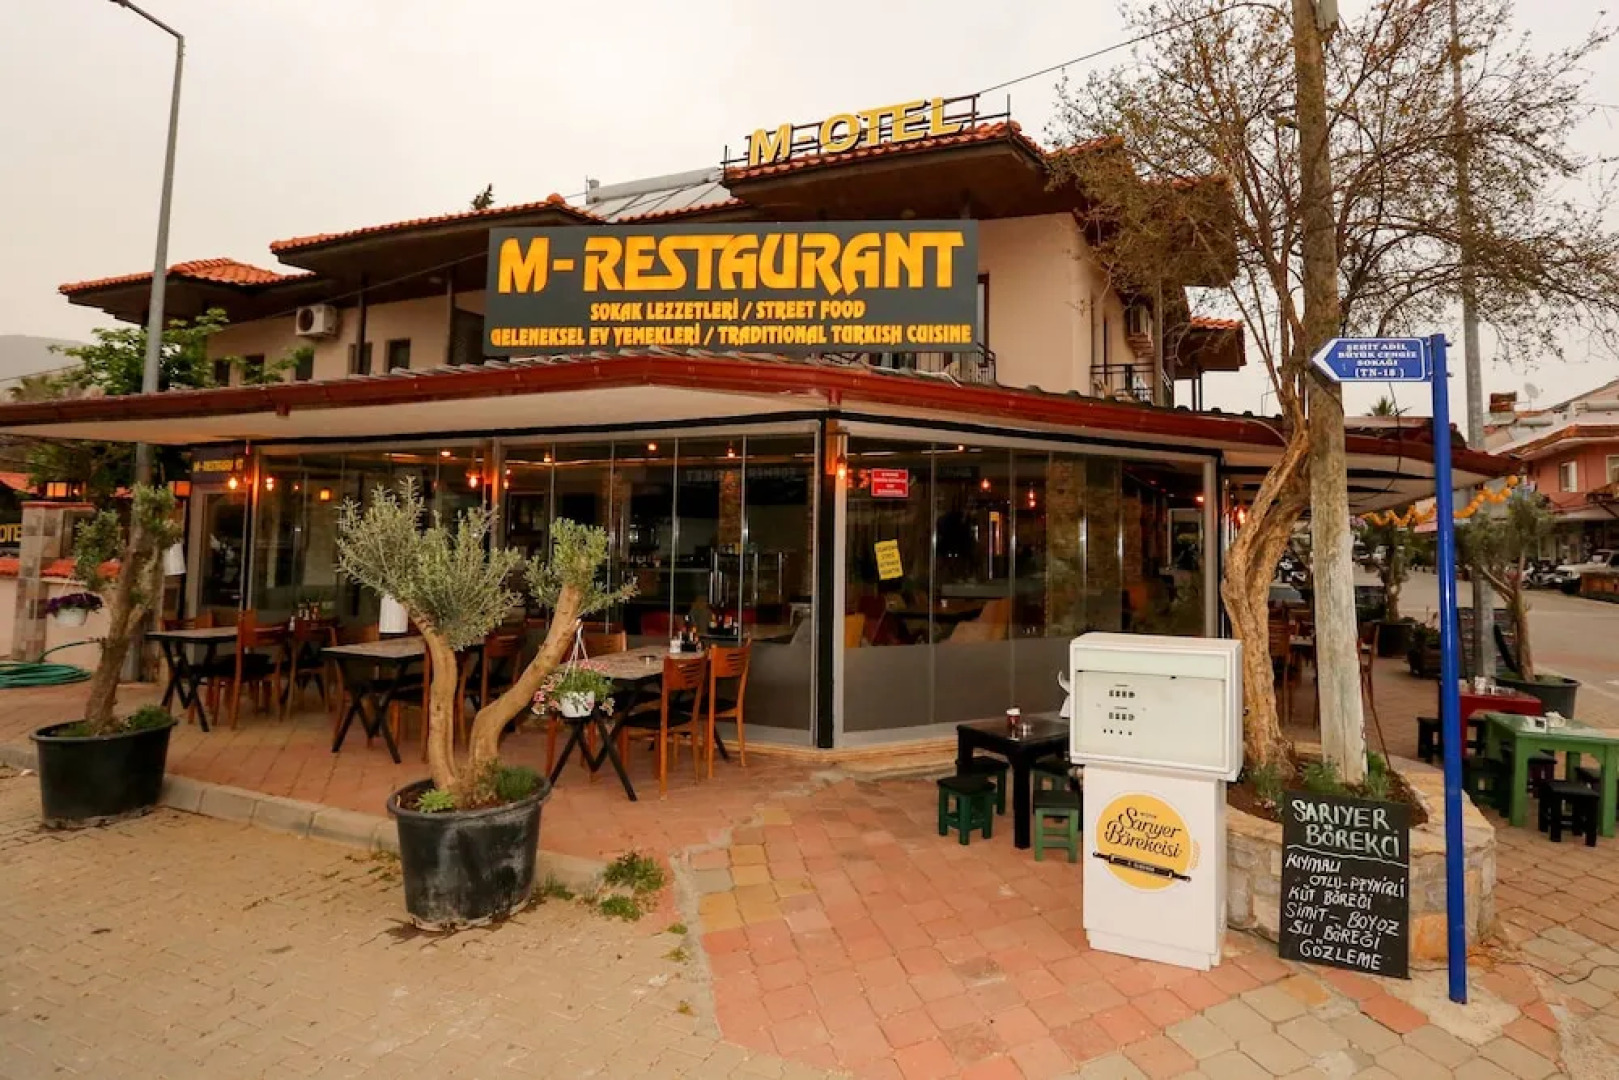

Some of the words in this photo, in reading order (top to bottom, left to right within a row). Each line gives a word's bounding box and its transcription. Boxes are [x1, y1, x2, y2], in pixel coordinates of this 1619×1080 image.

[749, 97, 963, 166] M-OTEL
[590, 302, 642, 322] SOKAK
[647, 298, 738, 321] LEZZETLERİ
[756, 300, 816, 321] STREET
[821, 300, 866, 319] FOOD
[491, 328, 586, 347] GELENEKSEL
[589, 327, 609, 345] EV
[613, 323, 700, 347] YEMEKLERİ
[718, 325, 827, 346] TRADITIONAL
[831, 325, 902, 345] TURKISH
[907, 325, 972, 344] CUISINE
[1291, 799, 1390, 830] SARIYER
[1305, 823, 1400, 858] BÖREKCİ
[1287, 919, 1314, 935] SU
[1323, 922, 1381, 950] BÖREĞİ
[1347, 911, 1400, 937] BOYOZ
[1299, 937, 1382, 971] GÖZLEME
